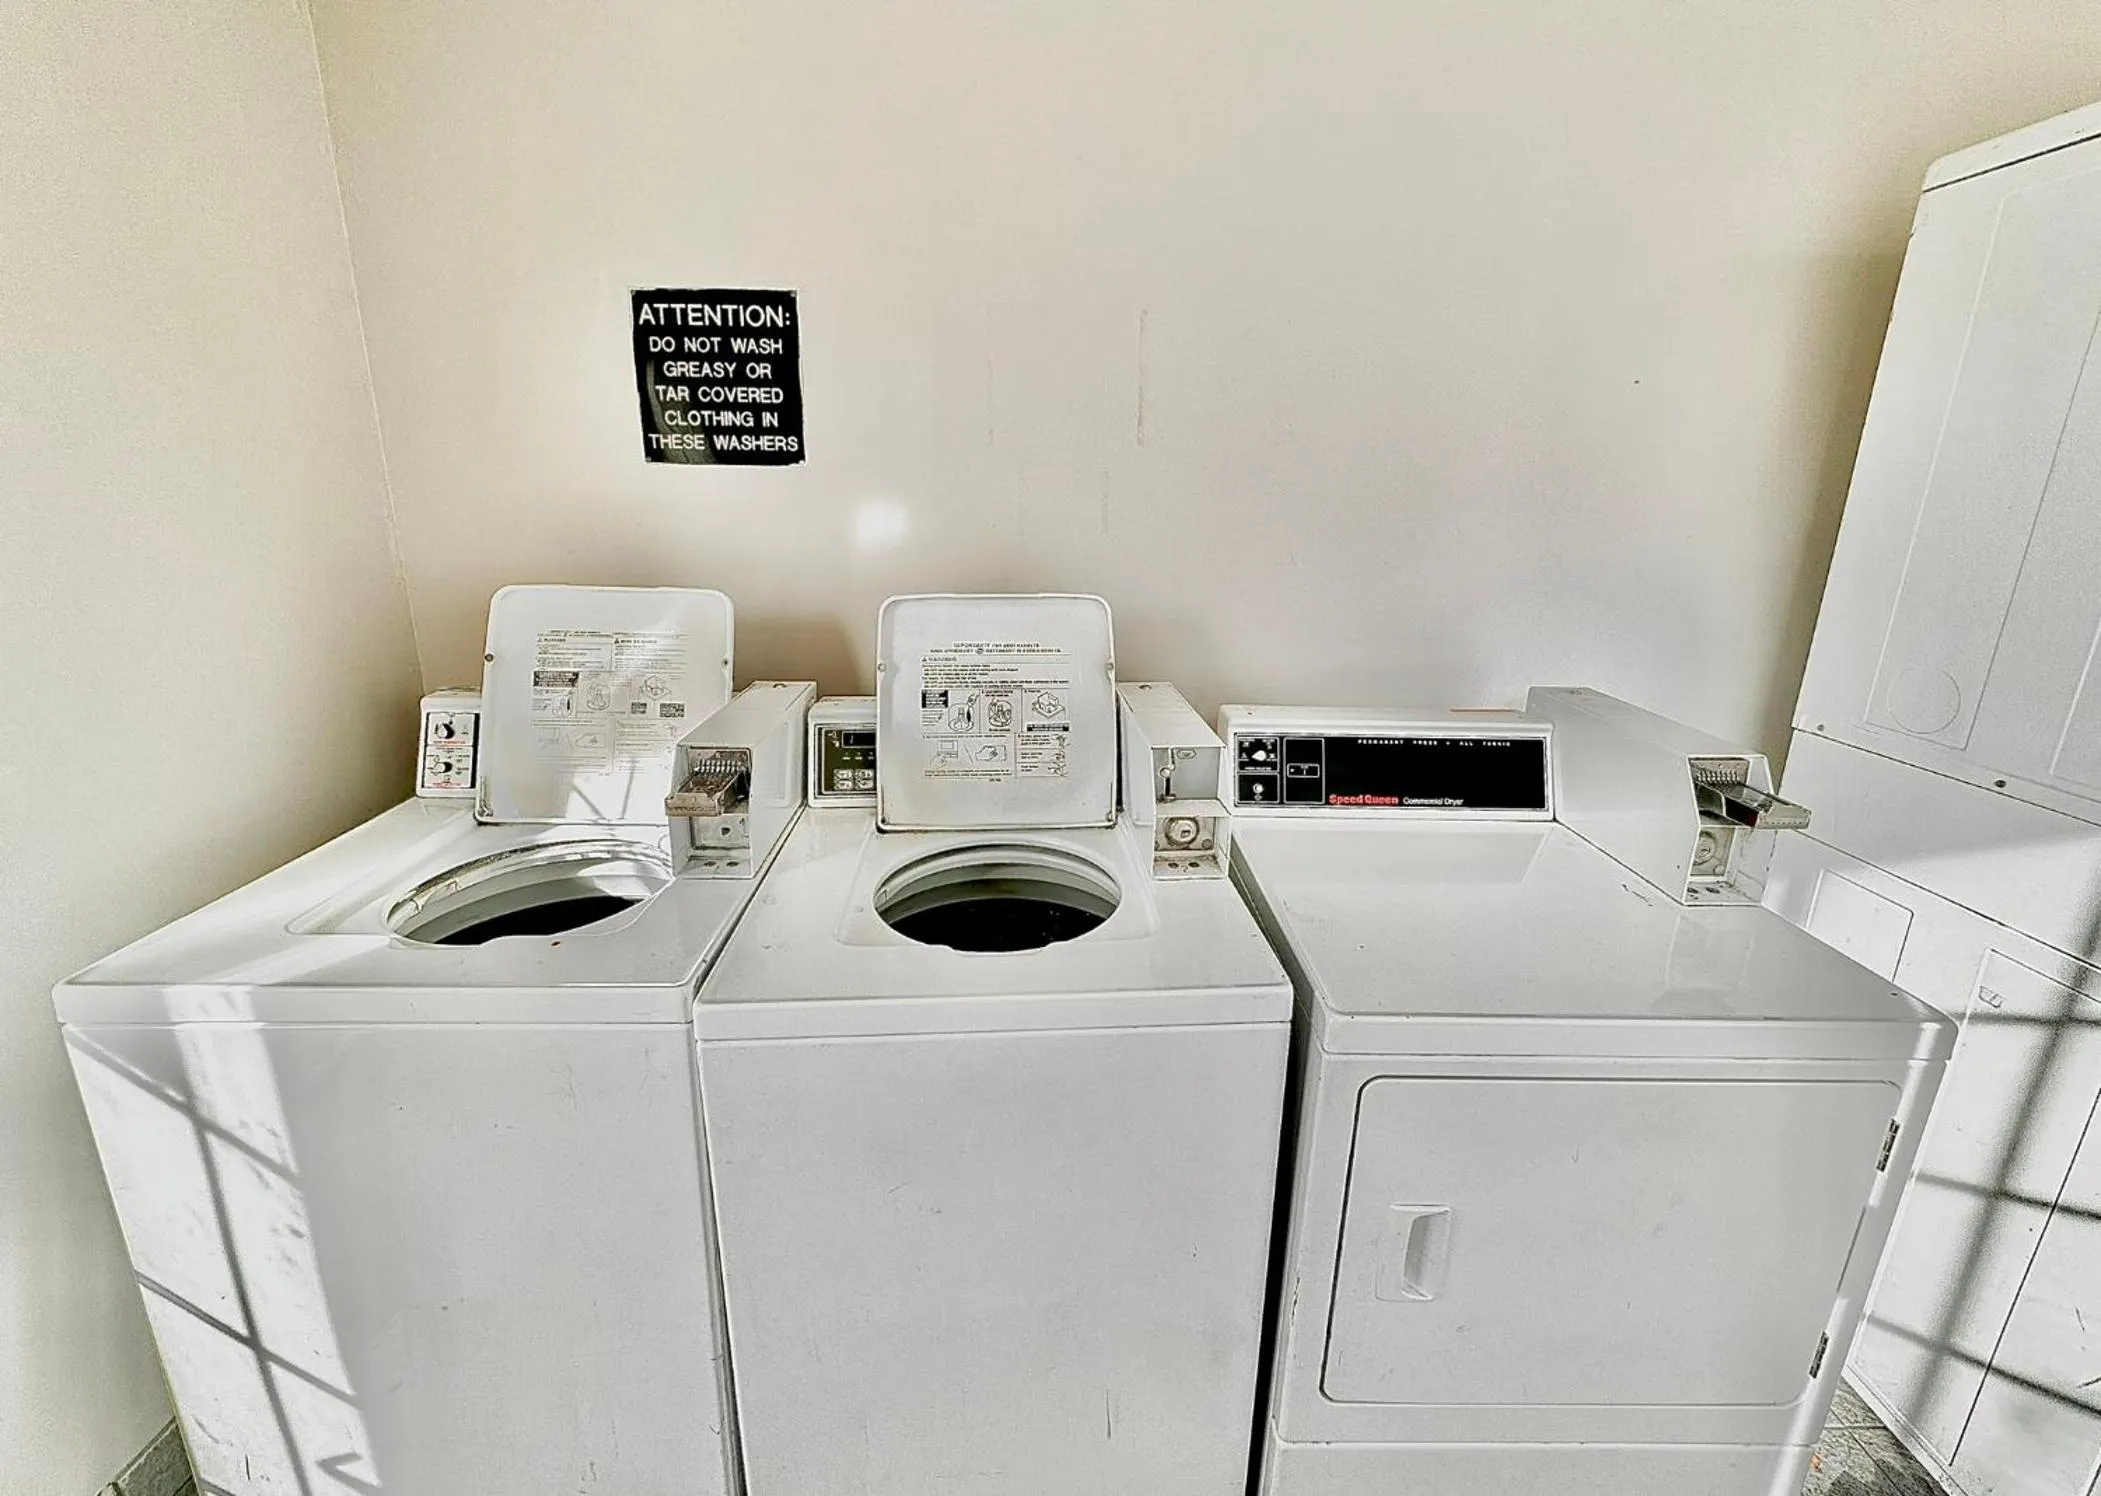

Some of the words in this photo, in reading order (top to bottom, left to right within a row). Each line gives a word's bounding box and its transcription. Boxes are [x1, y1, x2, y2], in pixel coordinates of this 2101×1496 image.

[638, 303, 791, 328] ATTENTION:
[648, 336, 676, 353] DO
[684, 336, 721, 353] NOT
[730, 337, 783, 355] WASH
[663, 361, 737, 379] GREASY
[745, 362, 773, 379] OR
[655, 385, 690, 403] TAR
[697, 386, 784, 405] COVERED
[664, 410, 754, 428] CLOTHING
[761, 411, 778, 428] IN
[648, 433, 705, 450] THESE
[713, 435, 799, 452] WASHERS
[1329, 794, 1364, 806] Speed
[1364, 794, 1399, 805] Queen
[1402, 796, 1443, 805] Commercial
[1443, 797, 1464, 806] Dryer
